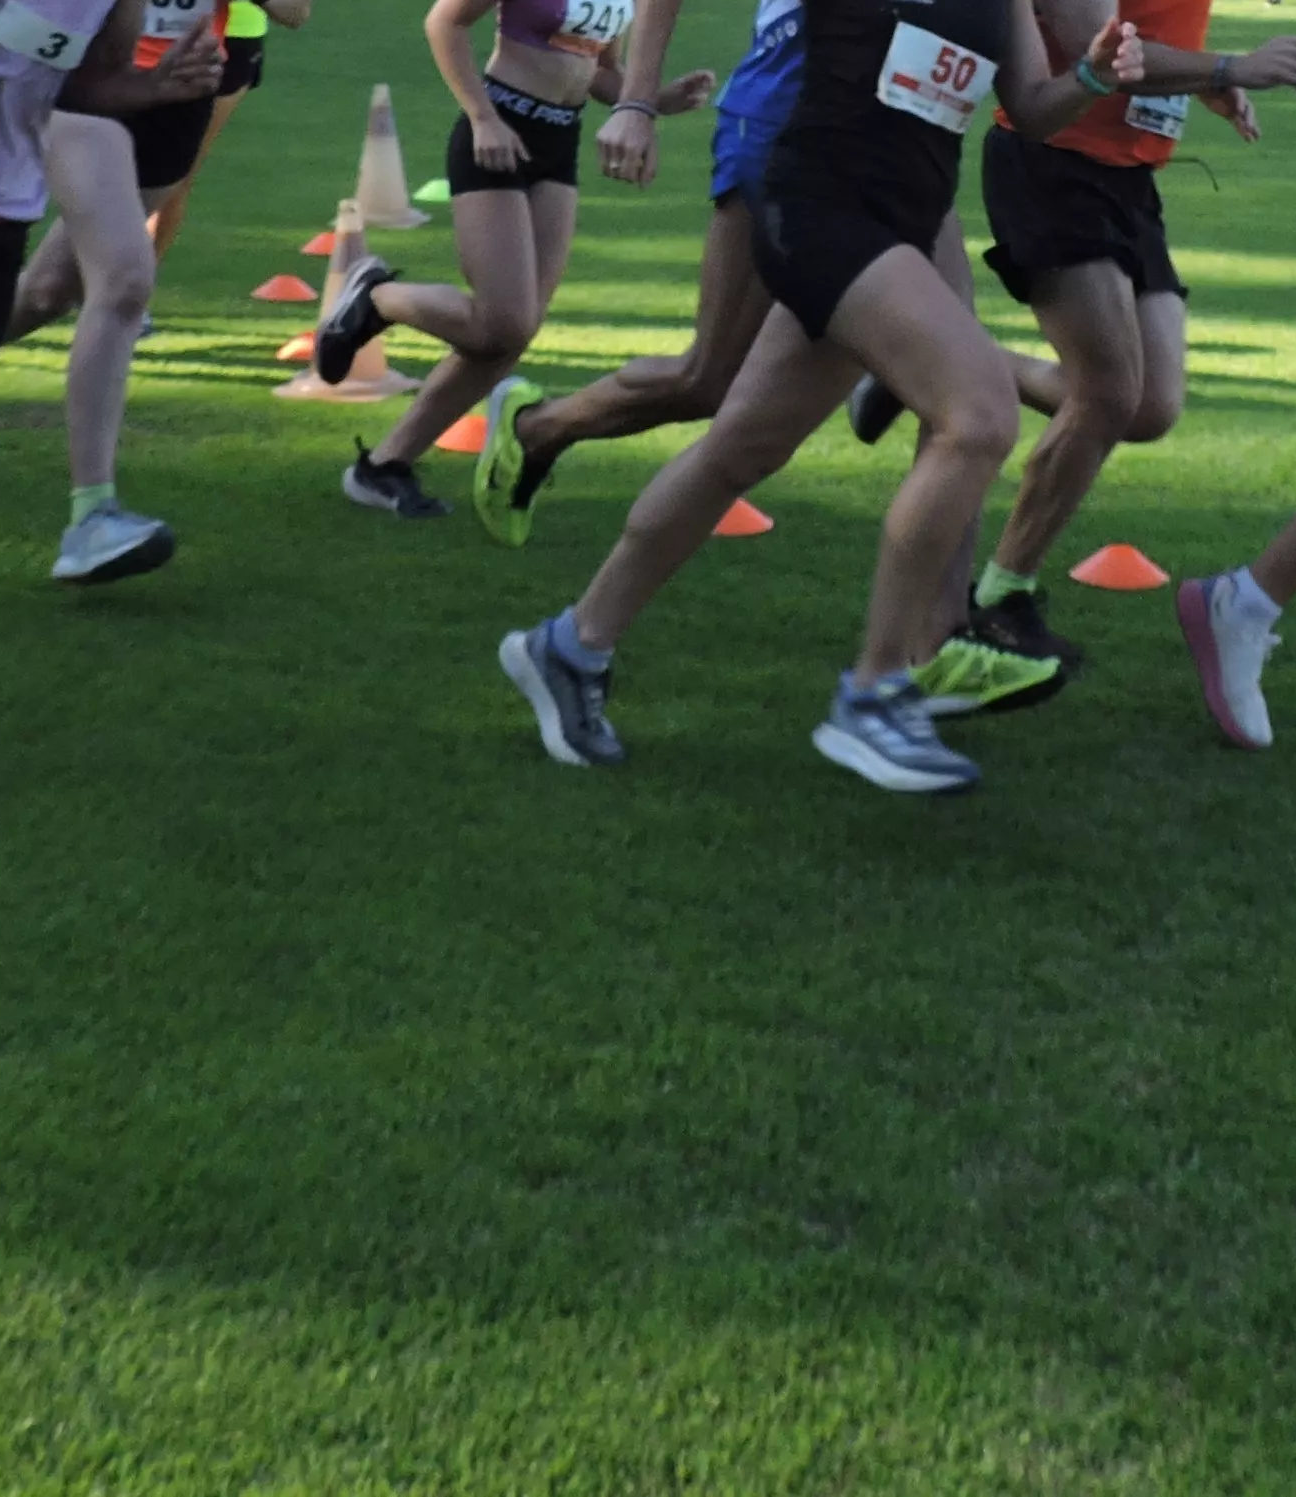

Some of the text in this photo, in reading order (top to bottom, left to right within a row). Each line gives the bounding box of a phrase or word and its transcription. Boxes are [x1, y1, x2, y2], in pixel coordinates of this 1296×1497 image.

[572, 1, 625, 41] 241
[37, 32, 69, 59] 3
[930, 46, 978, 92] 50
